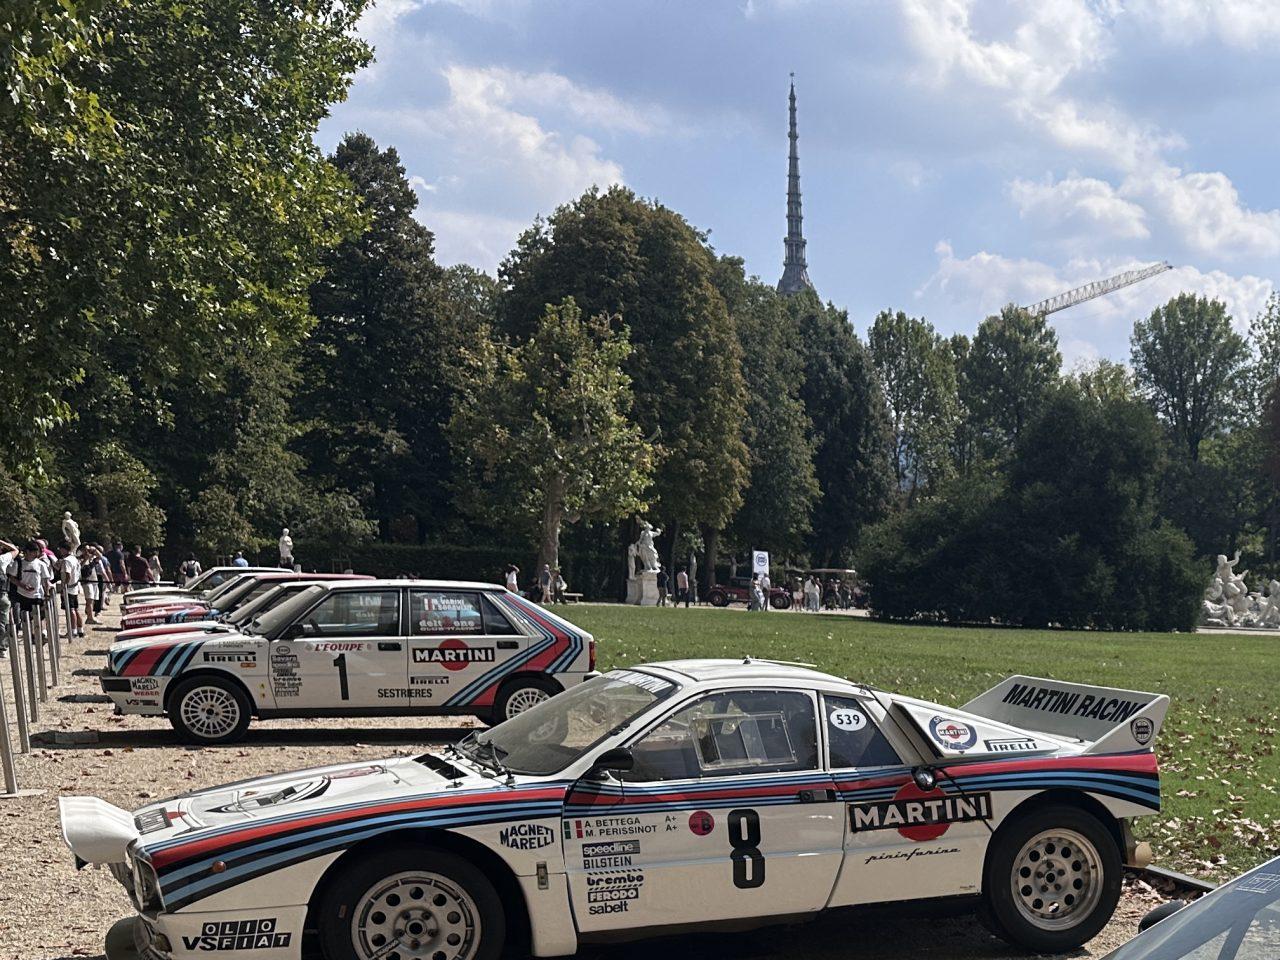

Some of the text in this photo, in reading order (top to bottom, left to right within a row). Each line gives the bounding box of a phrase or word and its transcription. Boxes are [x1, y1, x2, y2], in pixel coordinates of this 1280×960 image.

[125, 617, 166, 626] MICHELIN
[204, 651, 256, 662] PIRELLI
[415, 648, 494, 662] MARTINI
[333, 653, 349, 700] 1
[410, 676, 449, 684] PIRELLI
[378, 689, 432, 698] SESTRIERES
[1002, 684, 1080, 715] MARTINI
[836, 713, 861, 726] 539
[984, 738, 1038, 751] PIRELLI
[853, 795, 990, 831] MARTINI
[584, 820, 594, 828] A.
[596, 817, 641, 827] BETTEGA
[500, 824, 554, 845] MAGNETI
[585, 830, 597, 838] M.
[599, 825, 657, 836] PERISSINOT
[500, 832, 554, 850] MARELLI
[583, 843, 634, 856] speedline
[728, 809, 766, 889] 8
[864, 846, 961, 864] pininfarina
[583, 856, 632, 869] BILSTEIN
[587, 874, 644, 886] brembo
[590, 890, 637, 902] FERODO
[589, 902, 629, 915] sabelt
[203, 921, 276, 935] OLIO
[182, 933, 291, 950] VS FIAT
